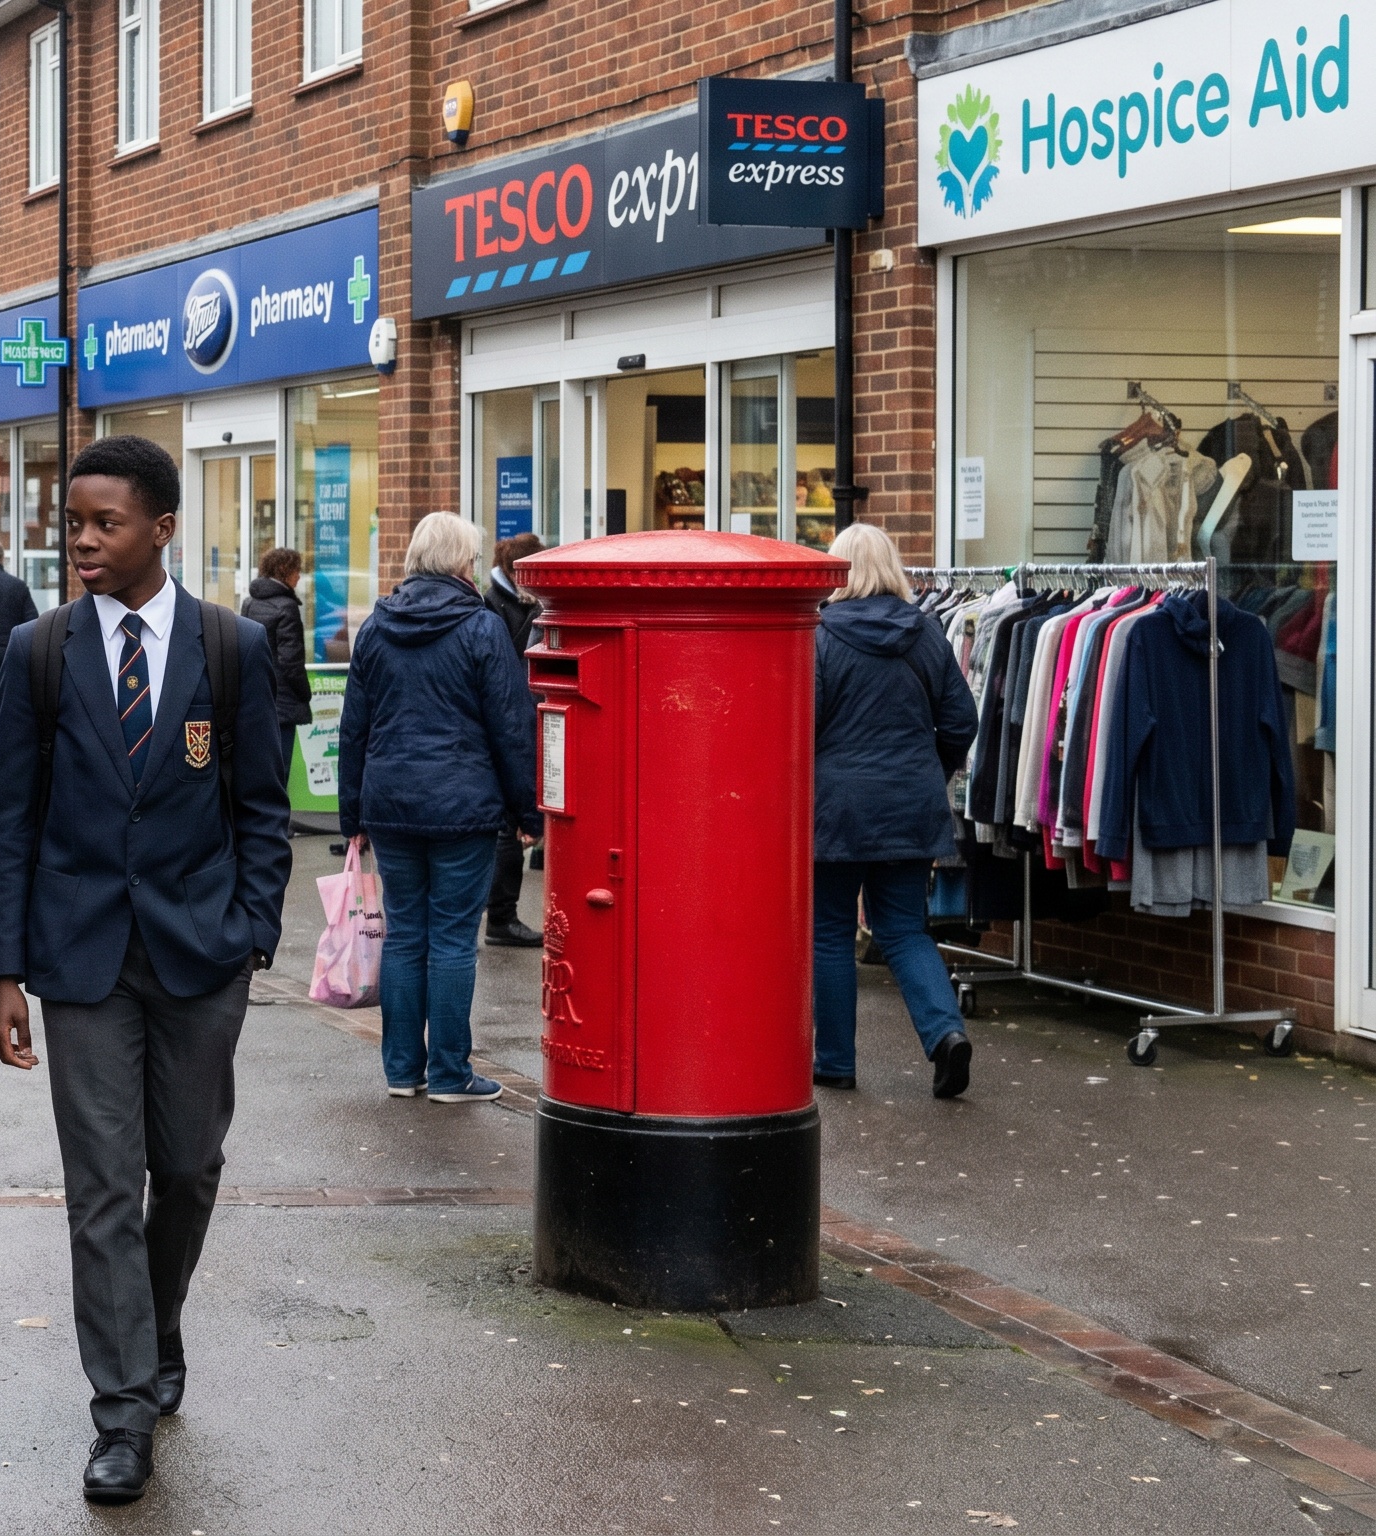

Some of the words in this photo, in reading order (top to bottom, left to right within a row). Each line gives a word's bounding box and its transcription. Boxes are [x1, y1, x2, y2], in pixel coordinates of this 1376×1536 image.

[727, 113, 848, 142] TESCO
[1021, 62, 1230, 179] Hospice
[1248, 14, 1350, 128] Aid
[444, 163, 594, 263] TESCO
[607, 148, 698, 243] expr
[728, 160, 845, 191] express
[105, 316, 171, 365] pharmacy
[250, 280, 334, 338] pharmacy
